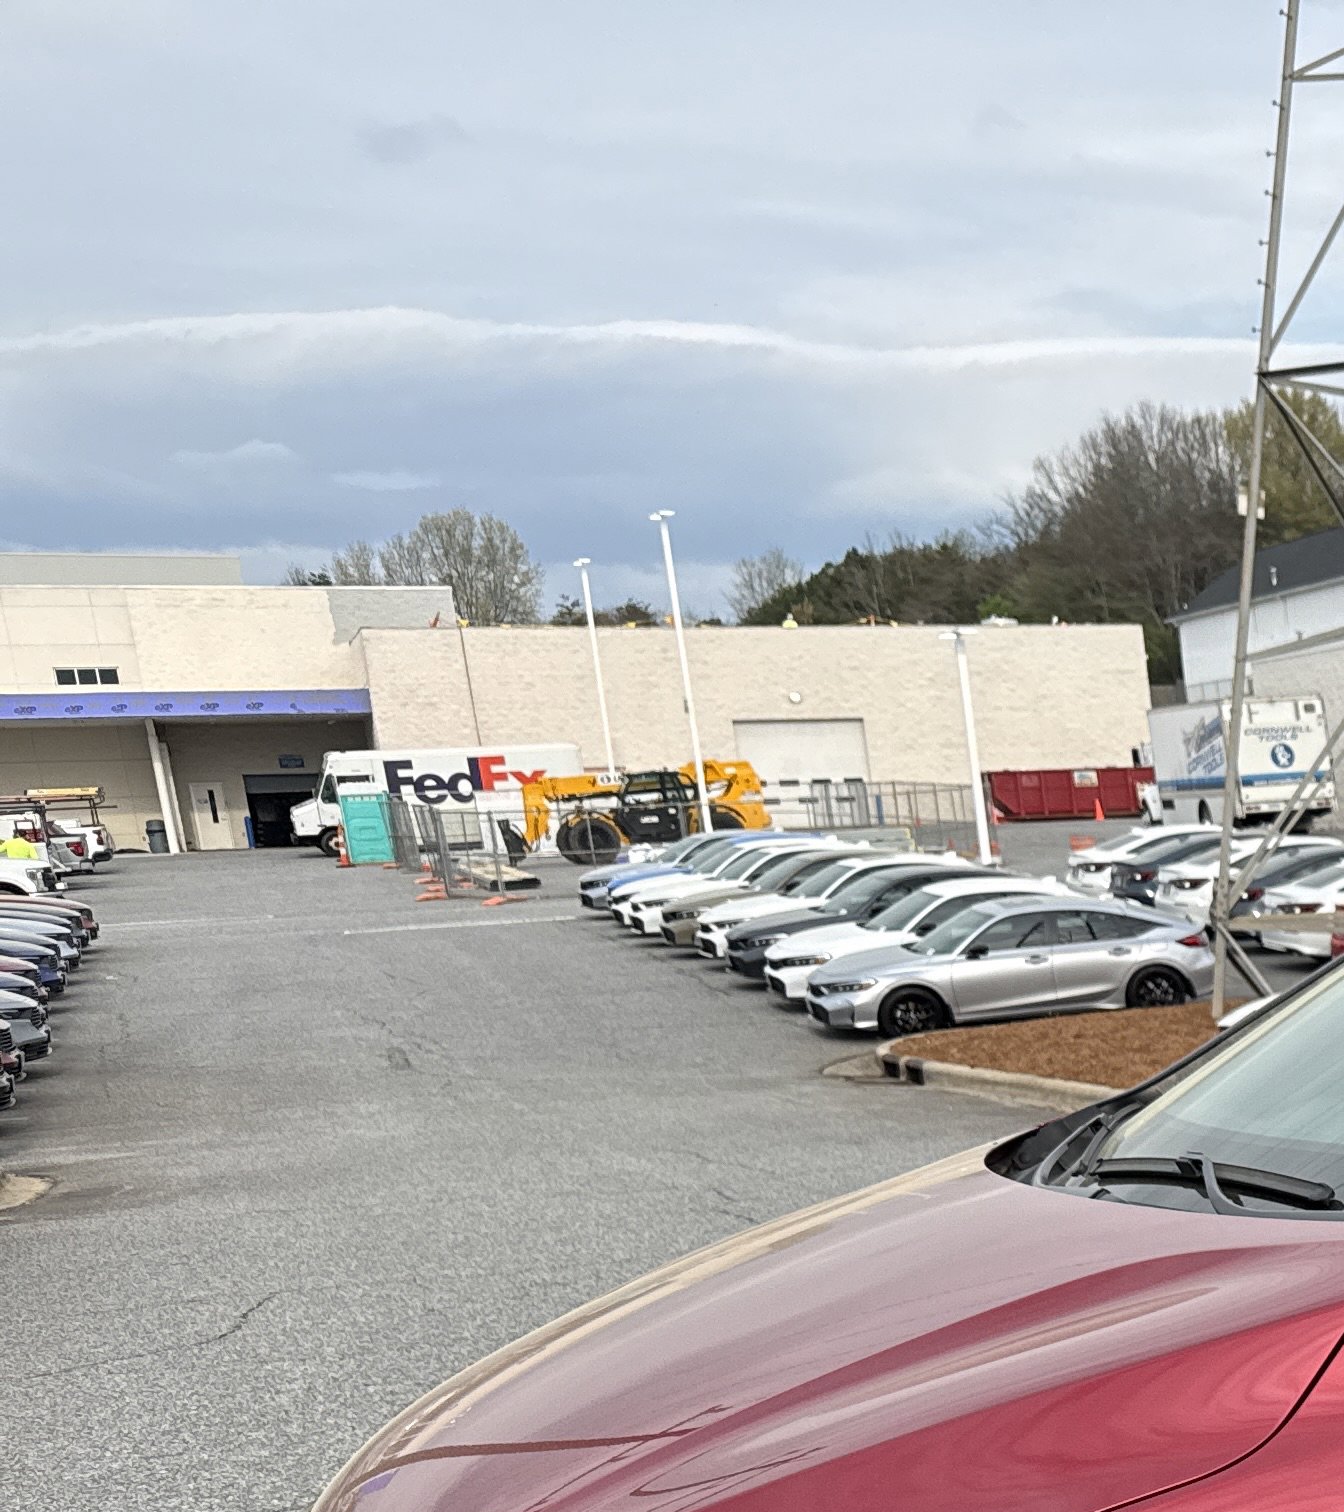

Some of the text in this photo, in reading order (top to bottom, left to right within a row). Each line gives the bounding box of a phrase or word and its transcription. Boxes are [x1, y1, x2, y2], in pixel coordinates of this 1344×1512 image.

[1244, 725, 1313, 737] CORNWELL
[1258, 734, 1299, 743] TOOLS
[383, 755, 547, 804] FedEx
